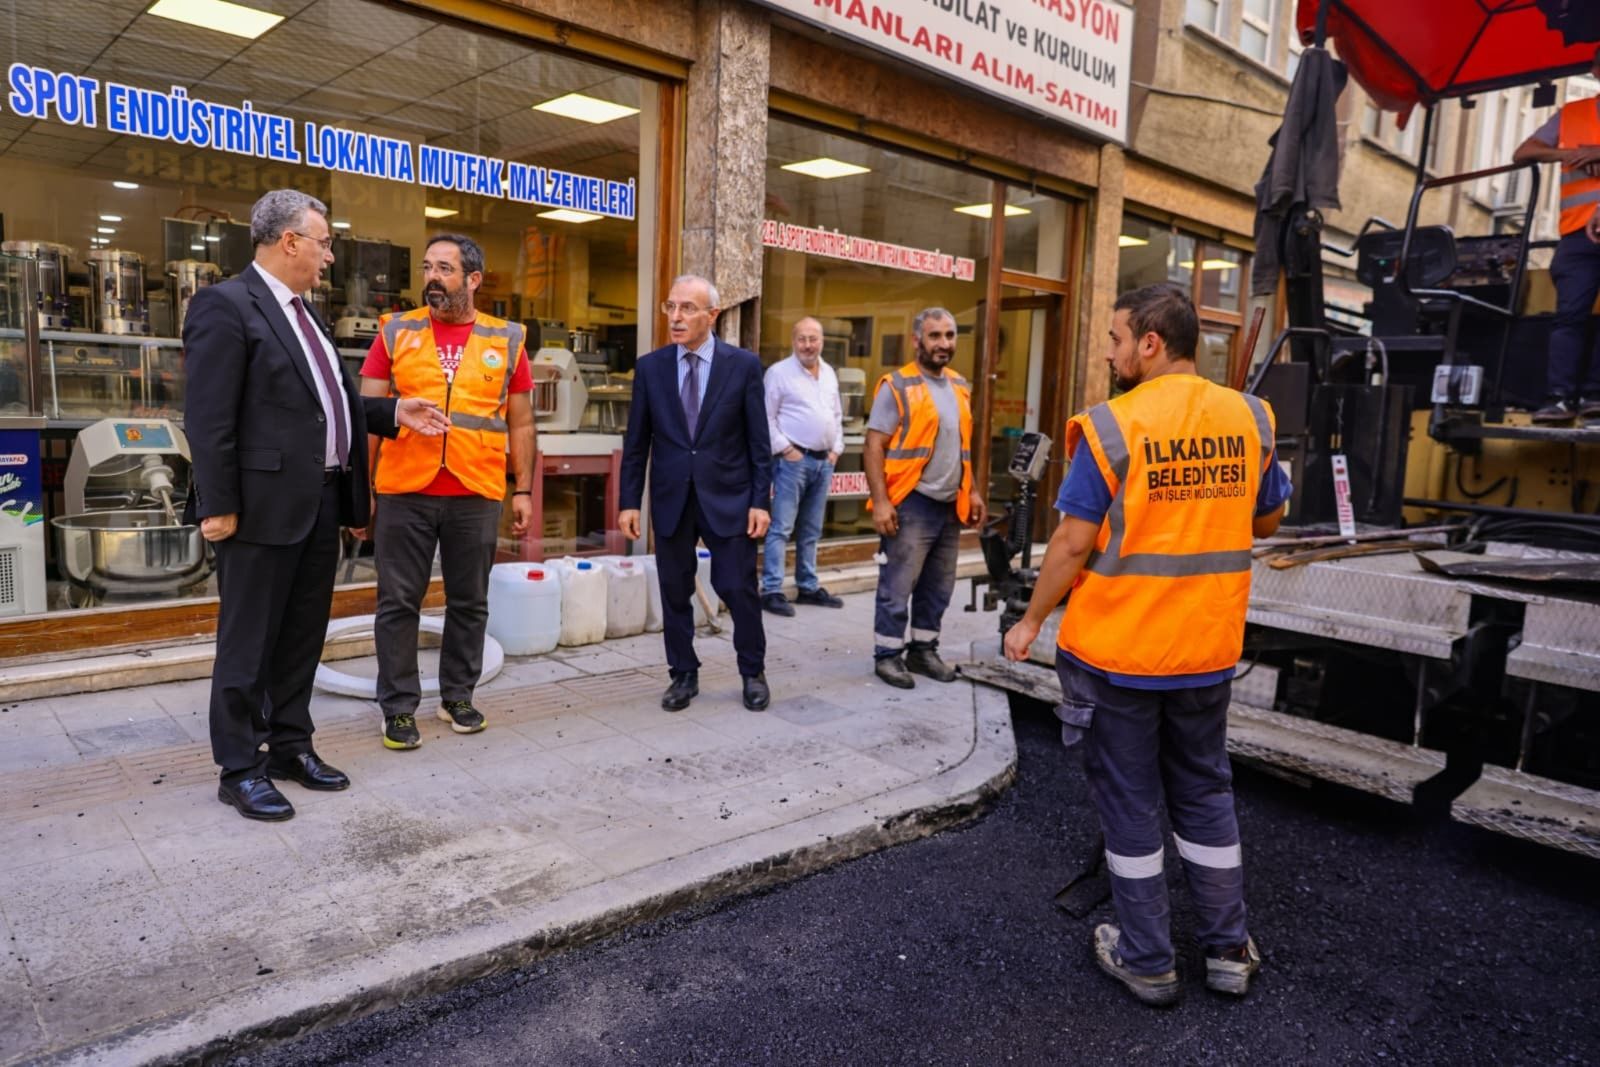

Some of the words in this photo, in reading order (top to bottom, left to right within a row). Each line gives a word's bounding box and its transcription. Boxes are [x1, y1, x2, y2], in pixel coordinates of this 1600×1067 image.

[1031, 0, 1119, 44] ASYON
[1006, 18, 1028, 47] ve
[1033, 27, 1116, 89] KURULUM
[970, 51, 1118, 129] ALIM-SATIMI
[11, 65, 97, 126] SPOT
[108, 84, 298, 161] ENDÜSTRİYEL
[305, 122, 413, 182] LOKANTA
[420, 145, 504, 197] MUTFAK
[509, 163, 635, 219] MALZEMELERİ
[1143, 435, 1246, 465] İLKADIM
[1147, 459, 1246, 490] BELEDİYESİ
[1148, 491, 1163, 502] FEN
[1164, 487, 1193, 502] İŞLERİ
[1194, 484, 1246, 499] MÜDÜRLÜĞÜ
